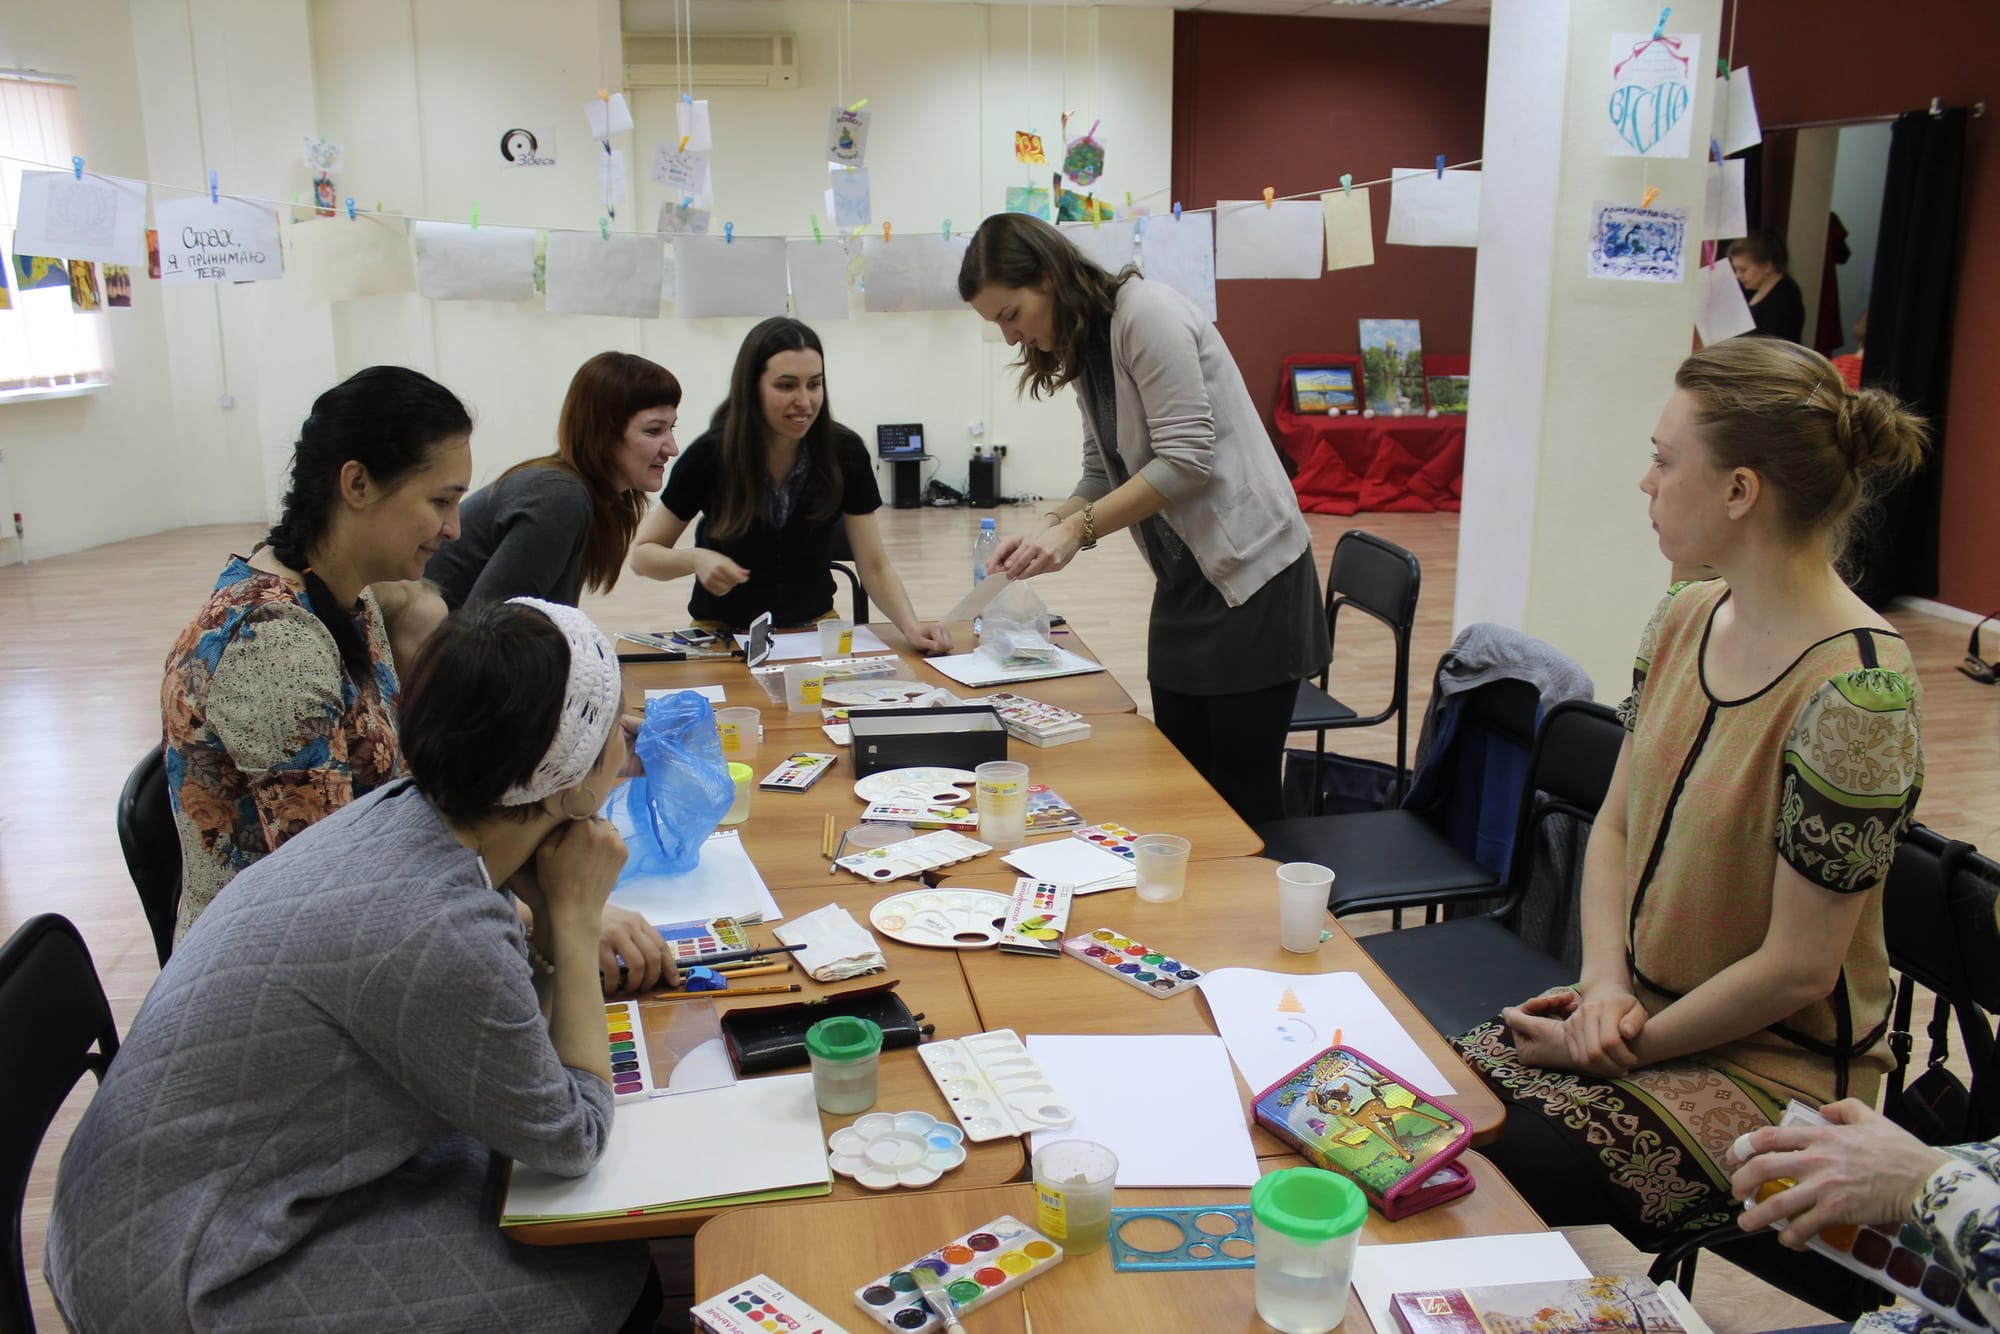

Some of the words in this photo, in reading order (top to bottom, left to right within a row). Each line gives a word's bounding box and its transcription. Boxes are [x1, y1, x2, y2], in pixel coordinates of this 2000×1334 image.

[1609, 82, 1688, 154] ВЕСНА
[188, 251, 266, 267] ПРИНИМАЮ
[194, 266, 226, 279] ТЕБЯ
[771, 1291, 785, 1301] 12
